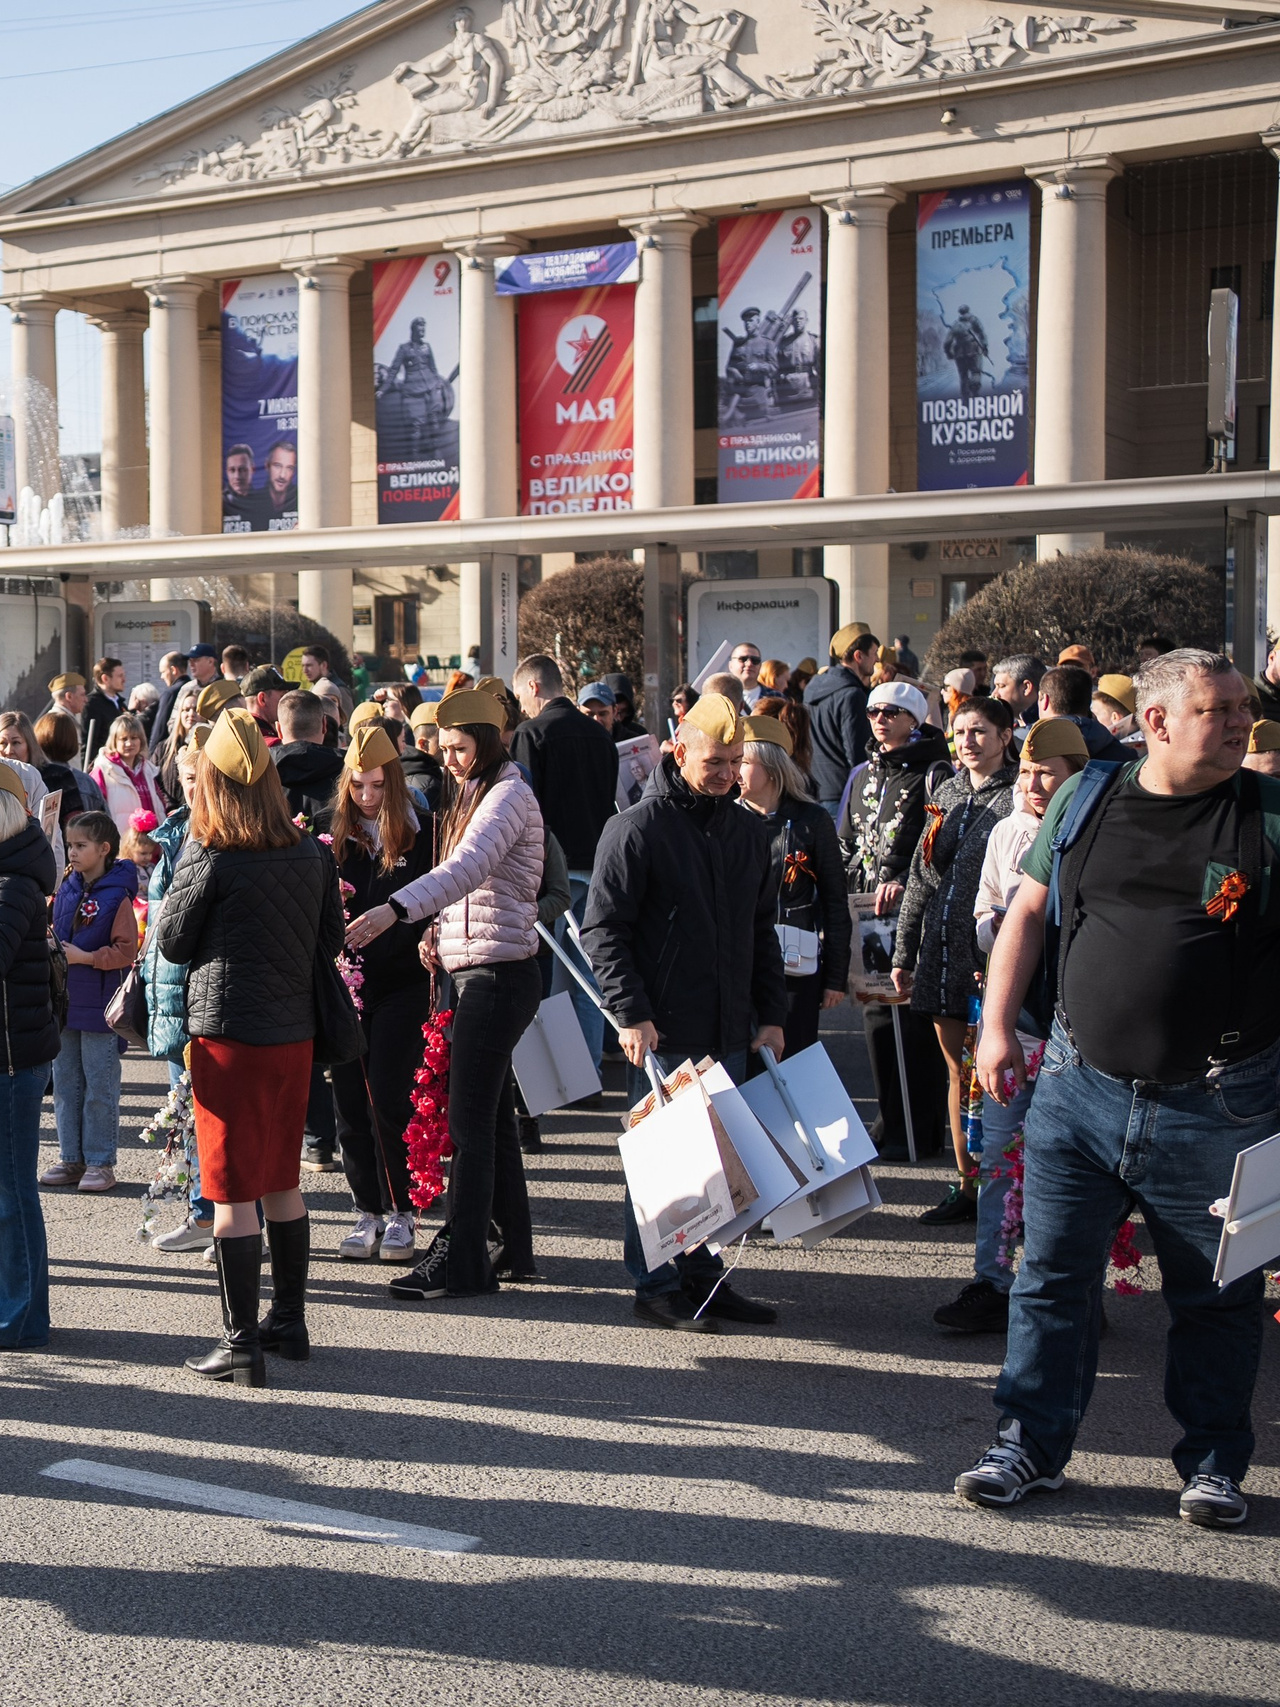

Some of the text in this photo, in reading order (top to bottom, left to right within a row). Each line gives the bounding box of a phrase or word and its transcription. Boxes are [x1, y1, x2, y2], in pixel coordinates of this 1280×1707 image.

[931, 222, 1014, 250] ПРЕМЬЕРА
[543, 262, 588, 278] КУЗБАССА
[228, 311, 298, 329] В ПОИСКАХ
[244, 323, 298, 336] СЧАСТЬЯ
[258, 399, 265, 415] 7
[555, 397, 616, 425] МАЯ
[922, 389, 1024, 424] ПОЗЫВНОЙ
[719, 432, 802, 447] С ПРАЗДНИКОМ
[931, 418, 1015, 447] КУЗБАСС
[530, 447, 634, 468] С ПРАЗДНИКО
[735, 440, 819, 464] ВЕЛИКОЙ
[378, 459, 446, 472] С ПРАЗДНИКОМ
[725, 461, 809, 480] ПОБЕДЫ!
[390, 466, 460, 488] ВЕЛИКОЙ
[382, 486, 452, 503] ПОБЕДЫ!
[942, 544, 999, 559] КАССА
[716, 599, 800, 612] Информация
[114, 619, 177, 630] Инфоря
